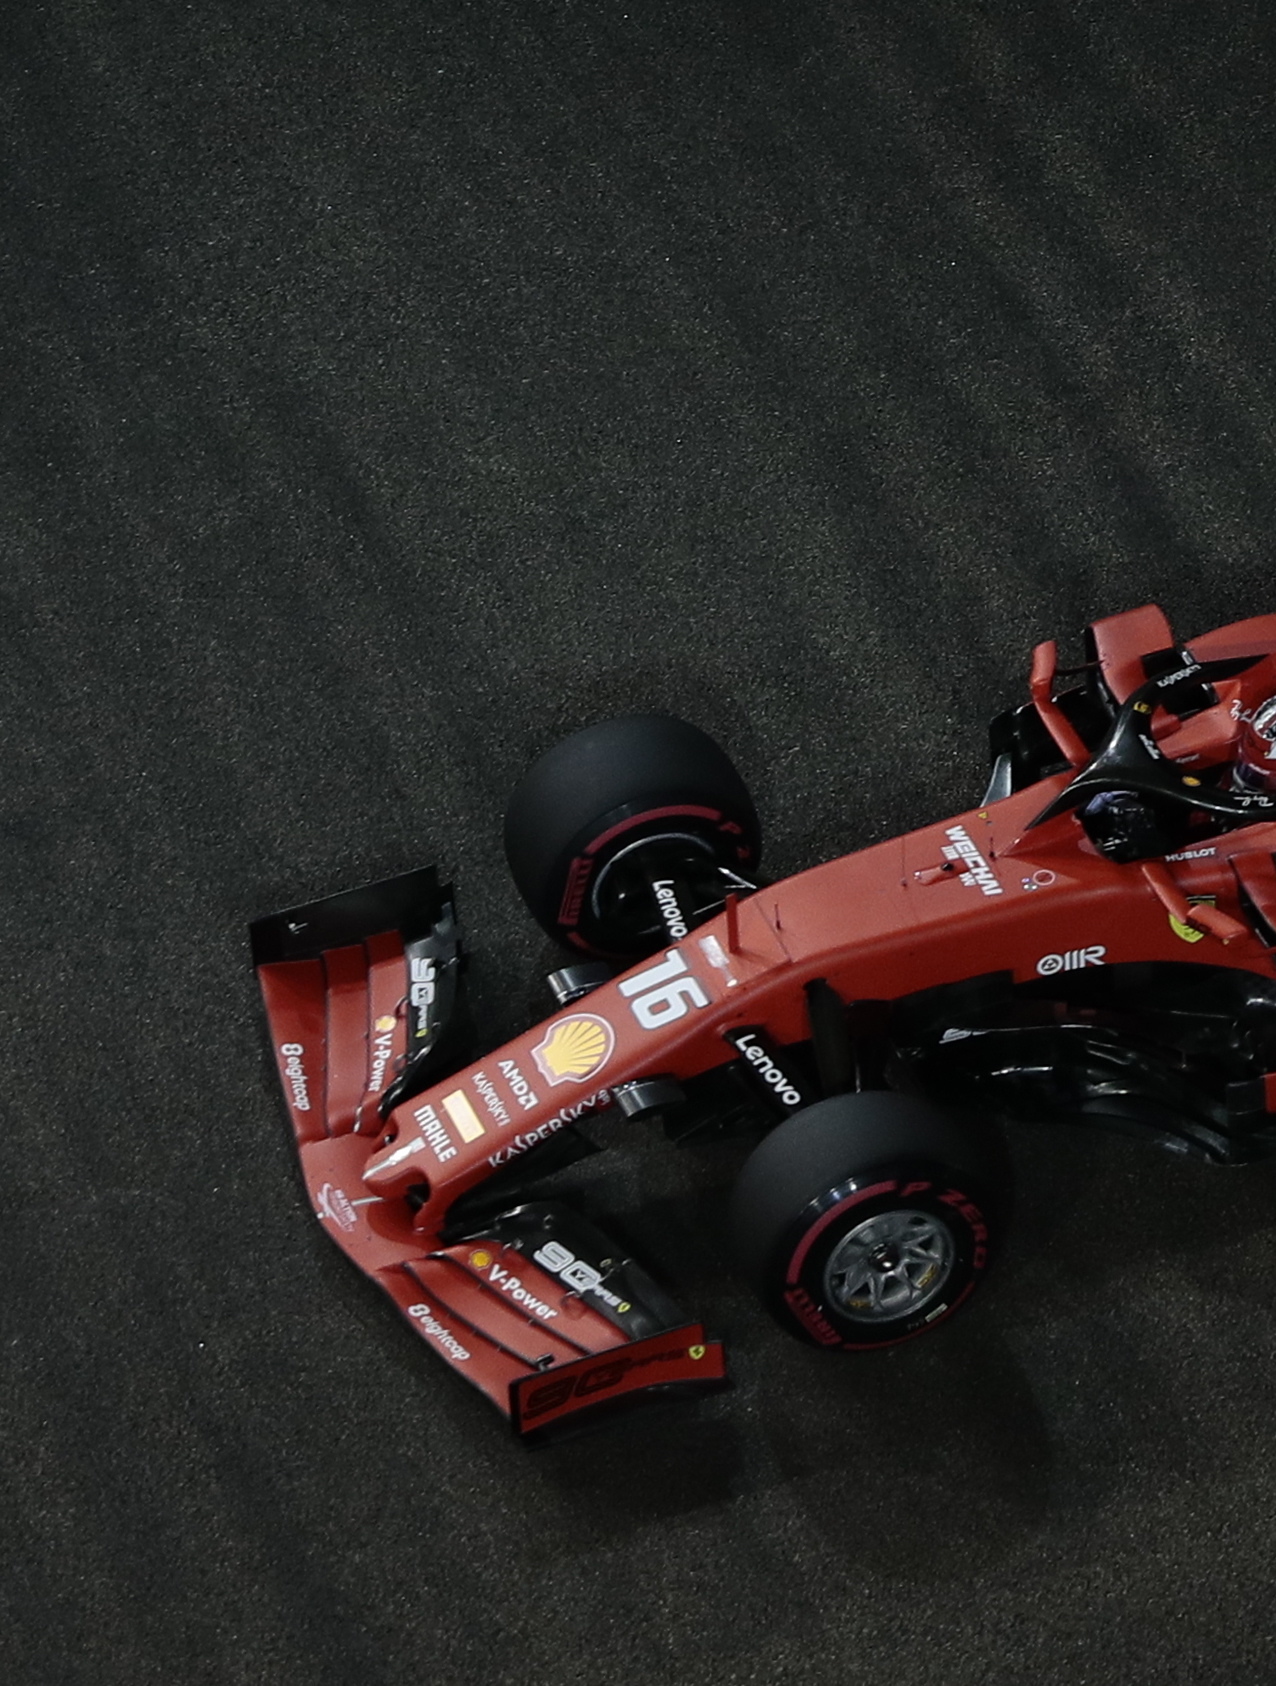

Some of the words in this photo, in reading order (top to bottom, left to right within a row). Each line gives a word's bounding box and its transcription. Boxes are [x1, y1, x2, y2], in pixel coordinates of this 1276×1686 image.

[944, 825, 1004, 896] WEICHAI
[1164, 847, 1216, 862] HUBLOT
[652, 880, 688, 938] Lenovo
[617, 947, 713, 1030] 16
[368, 1034, 393, 1093] V-Power
[498, 1059, 531, 1102] AMD
[734, 1034, 802, 1106] Lenovo
[414, 1104, 457, 1163] MAHLE
[489, 1265, 557, 1320] V-Power
